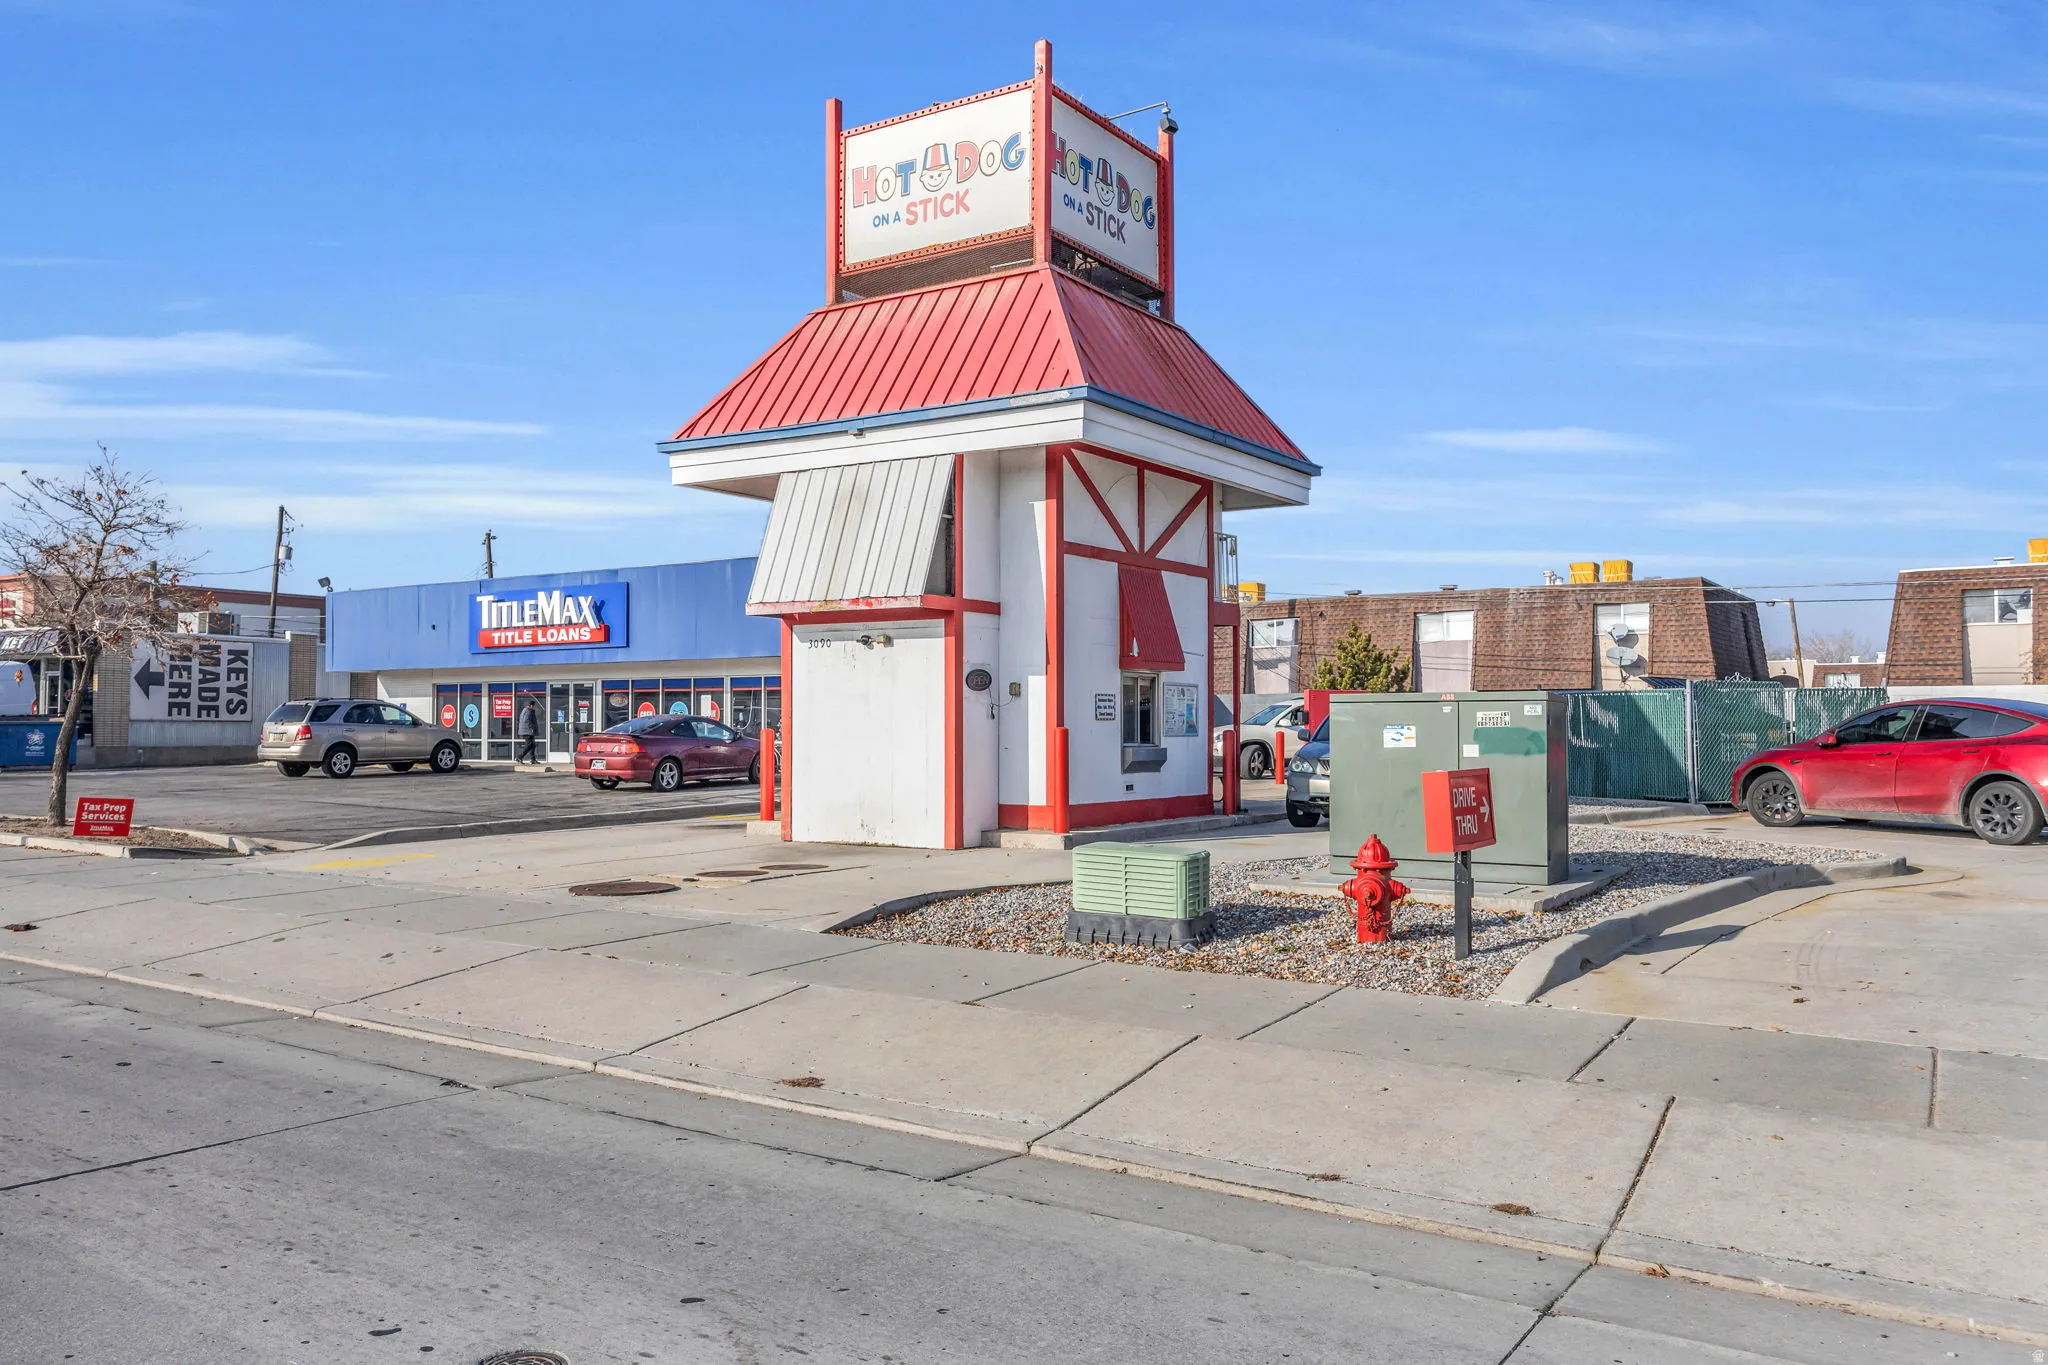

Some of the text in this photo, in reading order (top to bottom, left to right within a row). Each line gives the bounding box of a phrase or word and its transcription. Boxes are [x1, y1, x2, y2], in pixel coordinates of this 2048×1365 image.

[852, 132, 1027, 208] HOT DOG
[1050, 130, 1156, 230] HOT DOG
[872, 188, 970, 228] ON A STICK
[1063, 193, 1127, 245] ON A STICK
[491, 627, 592, 645] TITLE LOANS
[808, 638, 832, 649] 3090
[197, 644, 221, 719] MADE
[226, 649, 249, 716] KEYS
[82, 802, 127, 814] Tax Prep
[1452, 786, 1477, 808] DRIVE
[81, 811, 125, 821] Services
[1455, 814, 1478, 836] THRU
